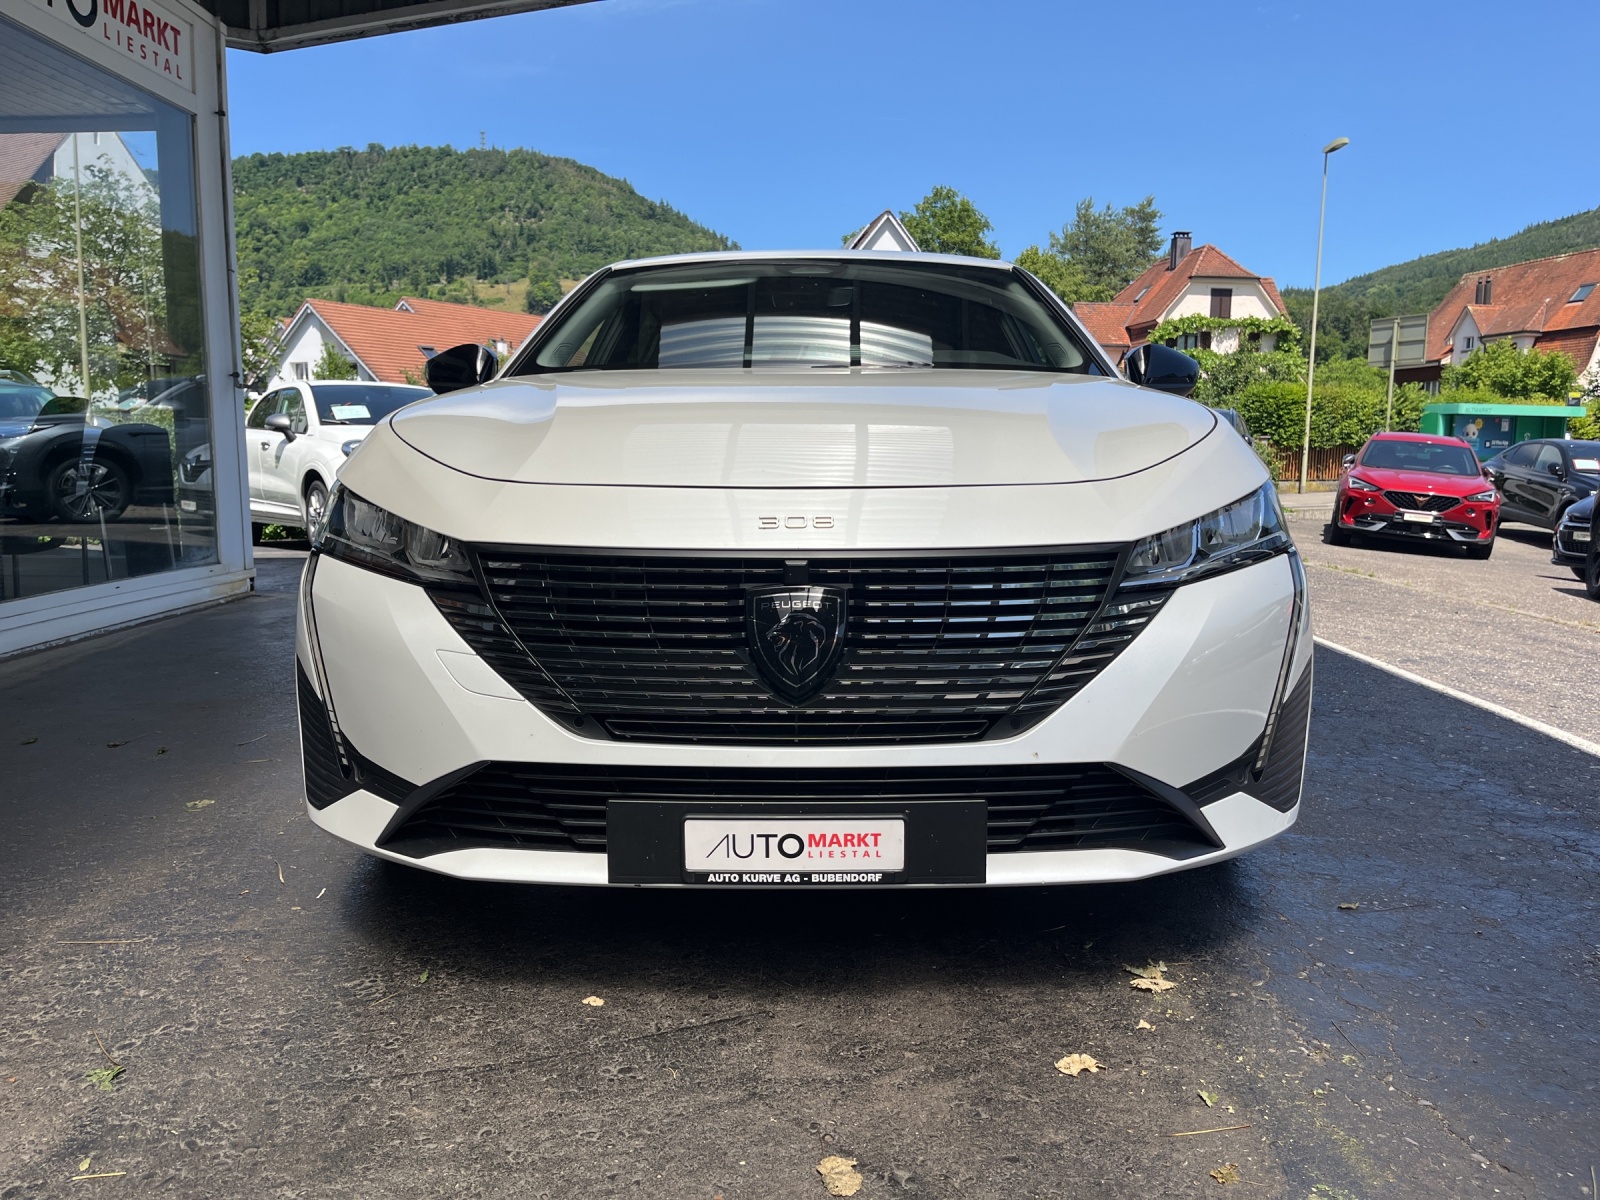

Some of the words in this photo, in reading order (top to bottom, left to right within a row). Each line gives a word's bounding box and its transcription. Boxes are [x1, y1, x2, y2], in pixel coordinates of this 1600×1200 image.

[103, 0, 181, 56] MARKT
[103, 22, 182, 80] LIESTAL
[758, 516, 835, 529] 308
[761, 600, 832, 610] PEUGEOT
[706, 833, 805, 859] AUTO
[808, 833, 882, 848] MARKT
[808, 850, 882, 859] LIESTAL
[707, 873, 740, 883] AUTO
[742, 873, 781, 883] KURVE
[783, 873, 800, 883] AG
[811, 873, 882, 883] BUBENDORF
